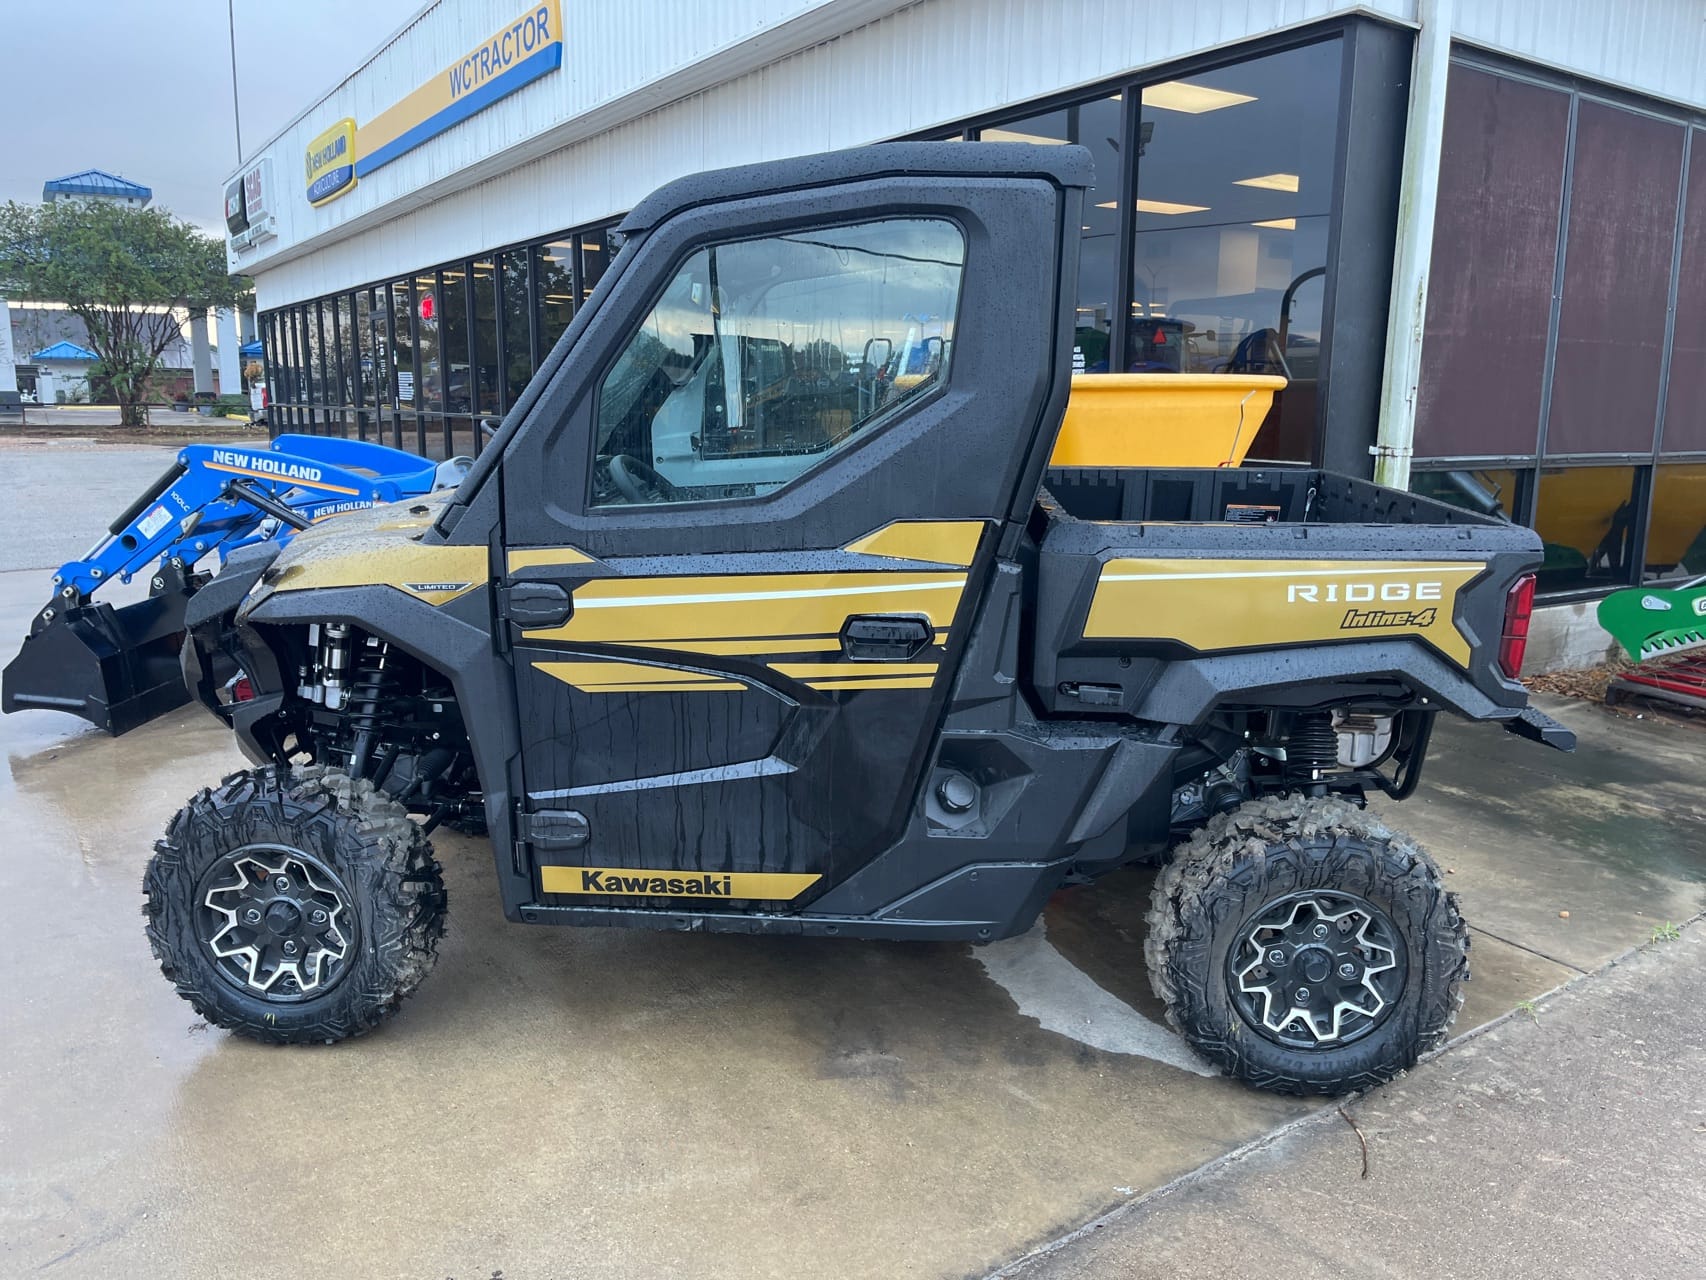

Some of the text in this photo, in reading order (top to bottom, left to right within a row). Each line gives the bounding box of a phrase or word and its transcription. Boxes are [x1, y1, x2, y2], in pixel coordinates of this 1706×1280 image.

[449, 6, 549, 98] WCTRACTOR
[213, 450, 322, 482] NEW HOLLAND
[313, 505, 336, 518] NEW
[1287, 582, 1442, 603] RIDGE
[1340, 608, 1438, 629] Inline-4
[581, 871, 731, 896] Kawasaki
